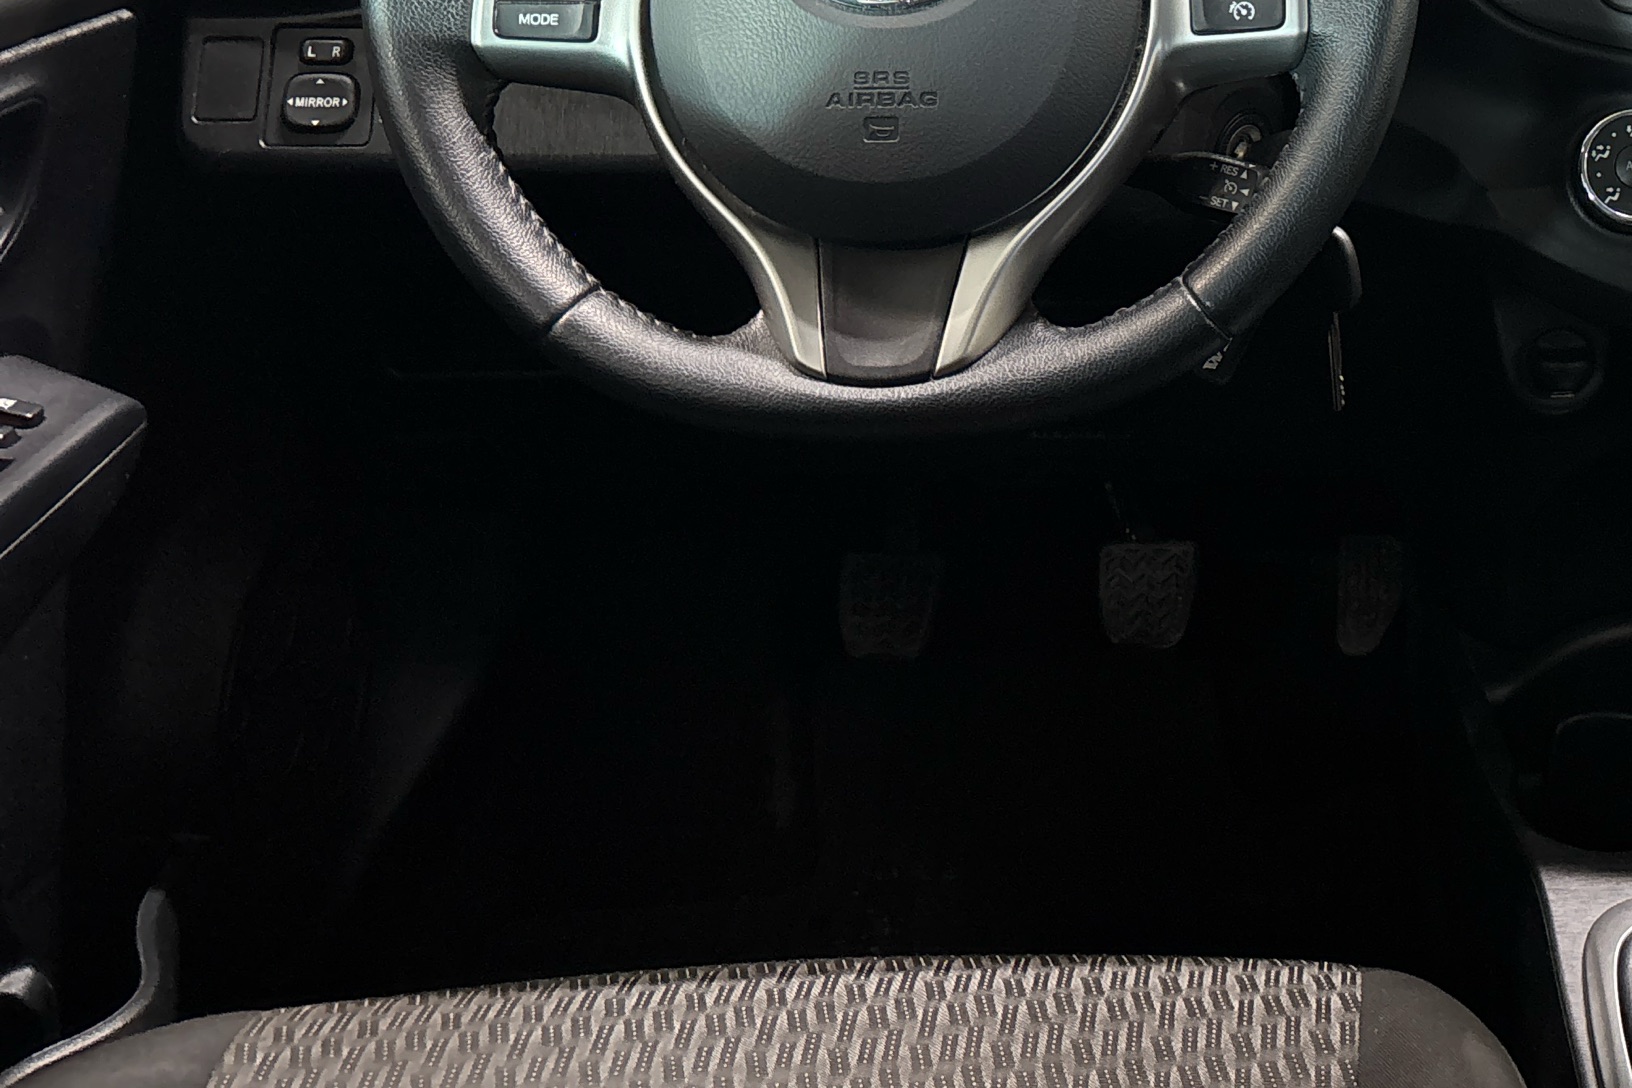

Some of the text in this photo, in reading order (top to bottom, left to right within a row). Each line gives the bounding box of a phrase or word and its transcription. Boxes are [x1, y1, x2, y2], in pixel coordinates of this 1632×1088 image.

[518, 13, 560, 26] MODE
[307, 45, 342, 58] L R
[853, 70, 911, 86] SRS
[294, 97, 341, 108] MIRROR
[825, 91, 939, 109] AIRBAG
[1220, 164, 1240, 177] RES
[1210, 195, 1230, 208] SET
